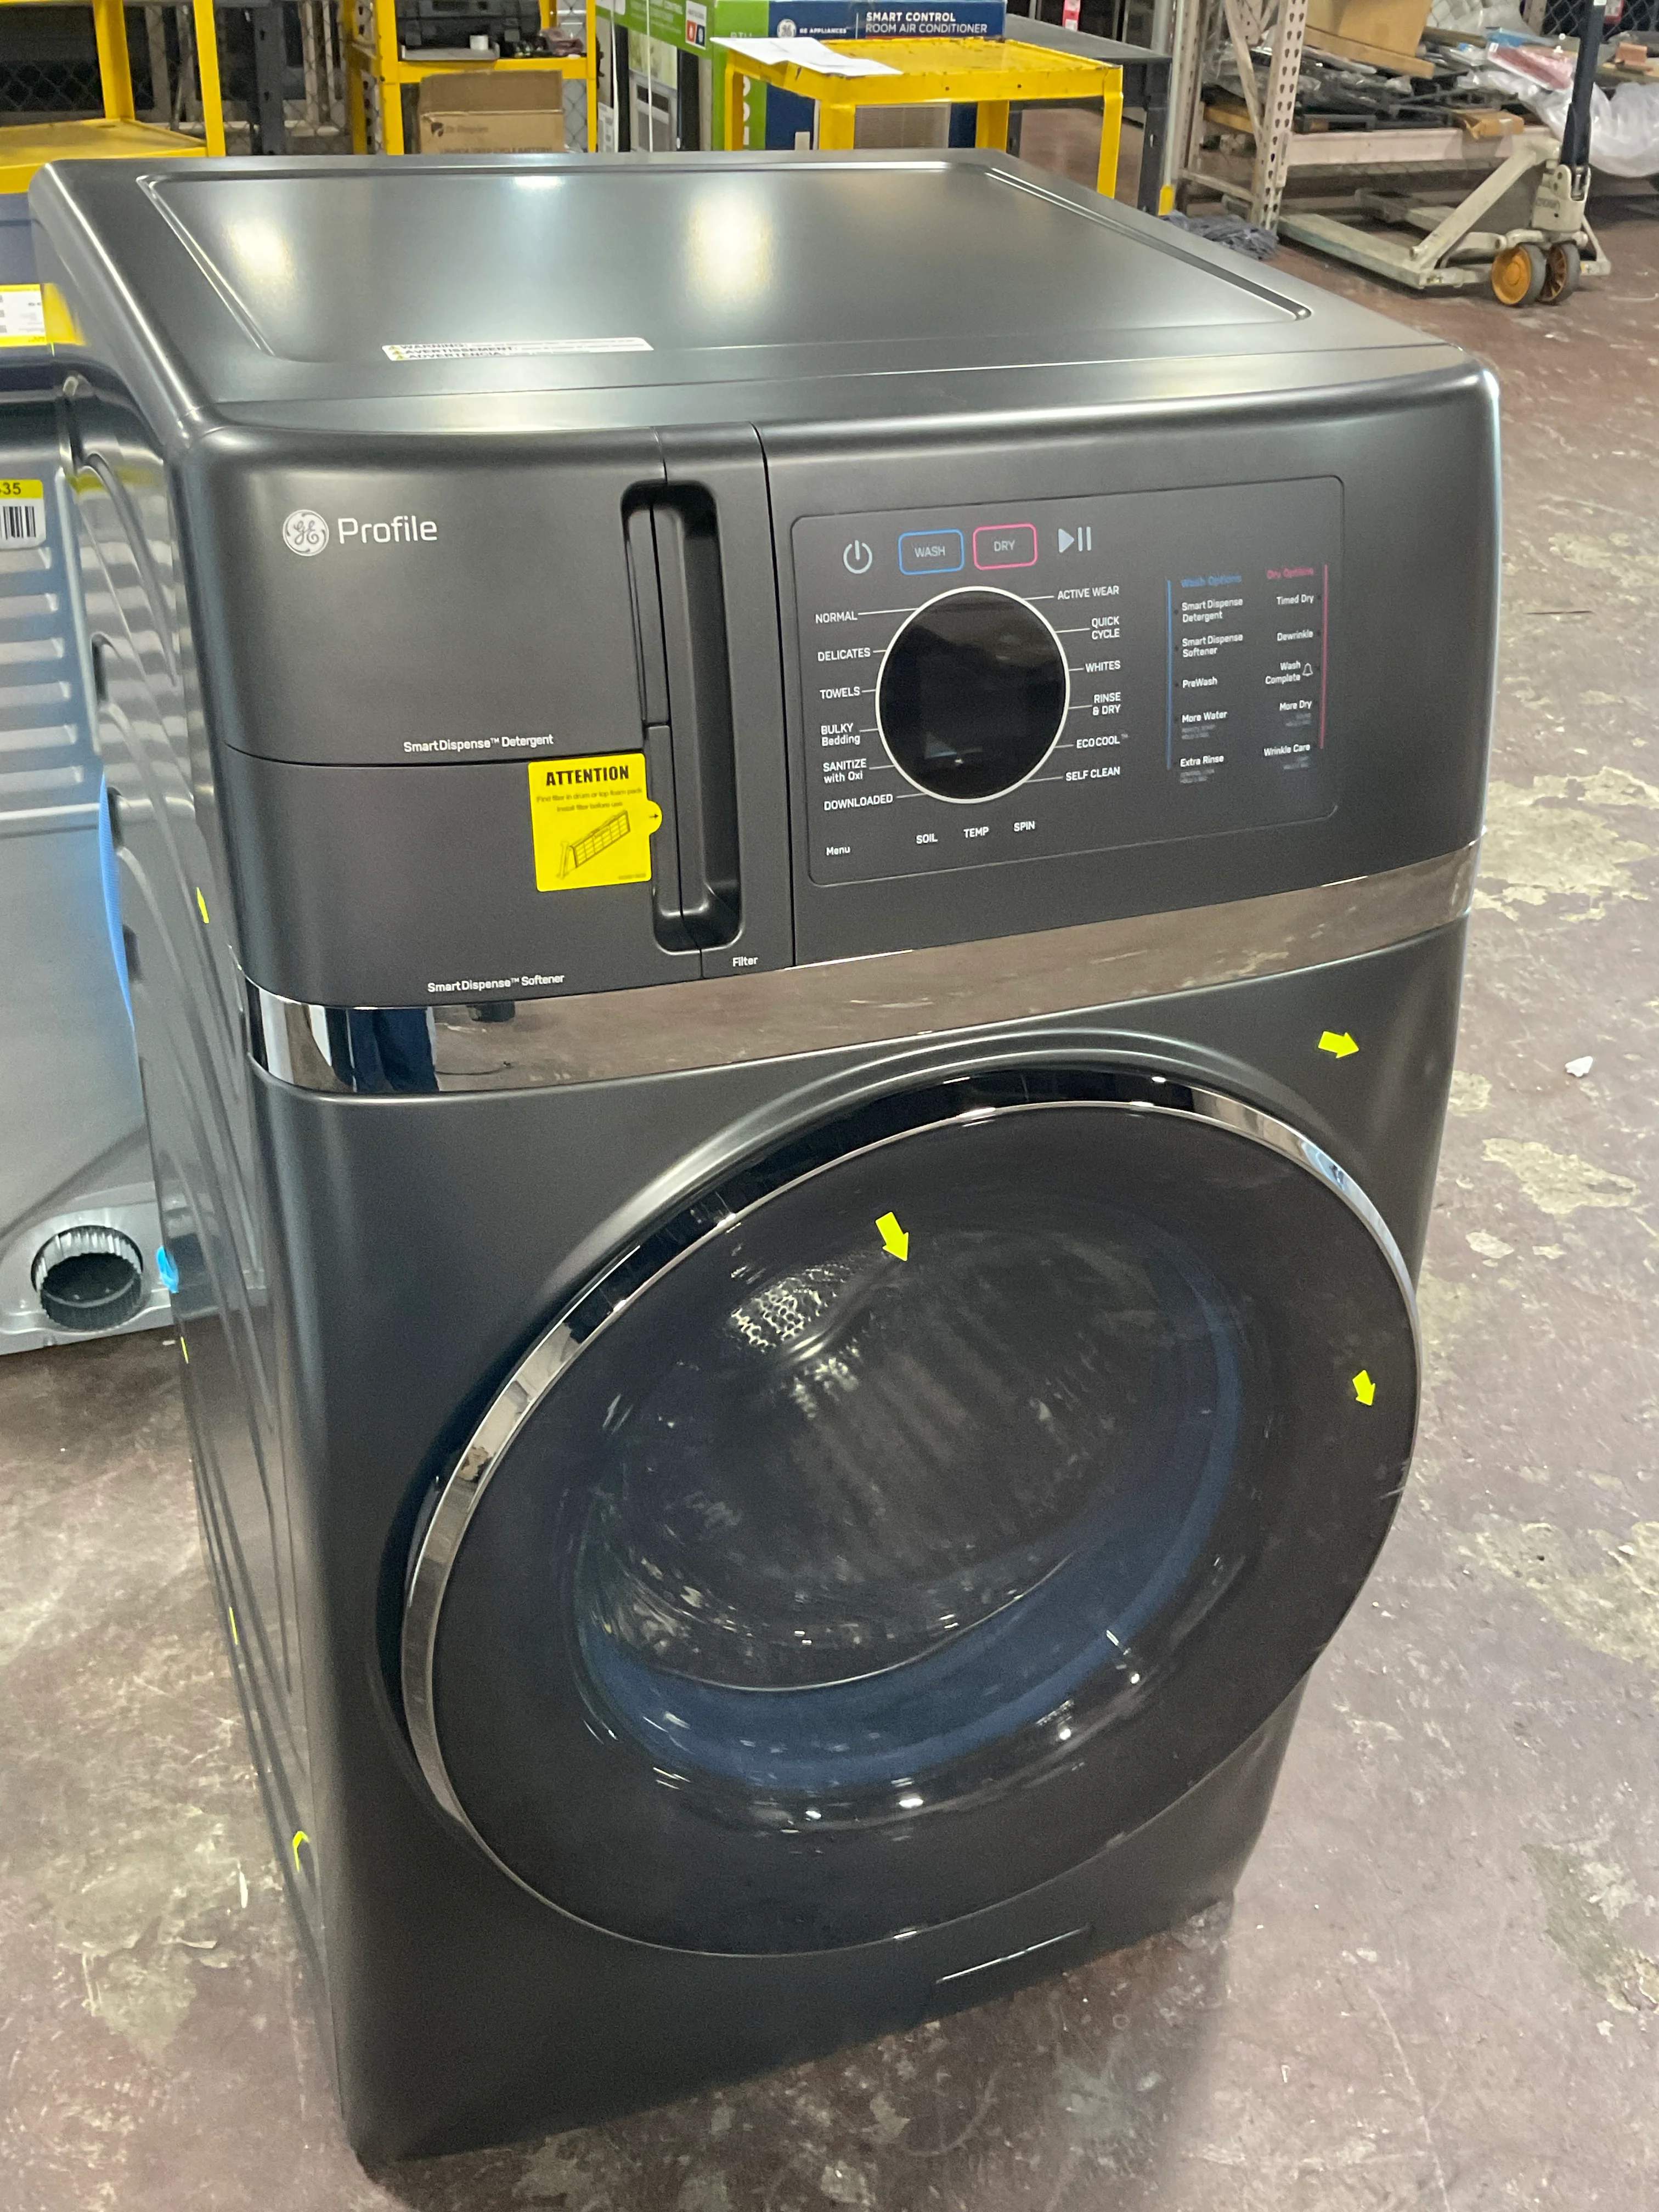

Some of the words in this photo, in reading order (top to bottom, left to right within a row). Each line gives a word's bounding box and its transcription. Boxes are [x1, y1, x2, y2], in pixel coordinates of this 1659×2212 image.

[866, 12, 902, 22] SMART
[905, 12, 956, 22] CONTROL
[865, 22, 897, 33] ROOM
[899, 22, 916, 33] AIR
[917, 22, 988, 33] CONDITIONER
[337, 515, 438, 544] Profile
[914, 546, 946, 558] WASH
[994, 540, 1015, 552] DRY
[1057, 588, 1090, 600] ACTIVE
[1092, 585, 1120, 597] WEAR
[1182, 601, 1206, 612] Smart
[1207, 598, 1244, 610] Dispense
[1276, 594, 1299, 605] Timed
[1301, 594, 1314, 603] Dry
[815, 610, 857, 624] NORMAL
[1091, 616, 1120, 629] QUICK
[1182, 610, 1223, 623] Detergent
[1091, 628, 1120, 640] CYCLE
[1182, 636, 1206, 647] Smart
[1207, 634, 1243, 645] Dispense
[1277, 629, 1314, 641] Dewrinkle
[817, 647, 871, 662] DELICATES
[1182, 647, 1218, 658] Softener
[1085, 660, 1121, 673] WHITES
[1280, 660, 1301, 671] Wash
[1182, 676, 1218, 689] PreWash
[1265, 673, 1301, 685] Complete
[820, 686, 860, 700] TOWELS
[1093, 691, 1121, 704] RINSE
[1092, 706, 1099, 716] &
[1101, 704, 1121, 715] DRY
[1279, 702, 1298, 711] More
[1299, 699, 1312, 709] Dry
[1182, 714, 1201, 723] More
[1203, 711, 1228, 721] Water
[821, 723, 854, 736] BULKY
[501, 733, 554, 748] Detergent
[822, 734, 860, 747] Bedding
[1263, 746, 1292, 757] Wrinkle
[1293, 743, 1311, 753] Care
[823, 758, 867, 773] SANITIZE
[1180, 758, 1201, 768] Extra
[1203, 755, 1224, 764] Rinse
[546, 765, 629, 786] ATTENTION
[823, 772, 845, 784] with
[848, 771, 863, 782] Oxi
[1065, 770, 1089, 782] SELF
[1090, 766, 1120, 778] CLEAN
[823, 793, 893, 811] DOWNLOADED
[963, 826, 989, 839] TEMP
[1013, 821, 1035, 833] SPIN
[916, 833, 938, 844] SOIL
[826, 845, 850, 856] Menu
[732, 956, 759, 967] Filter
[521, 974, 565, 986] Softener
